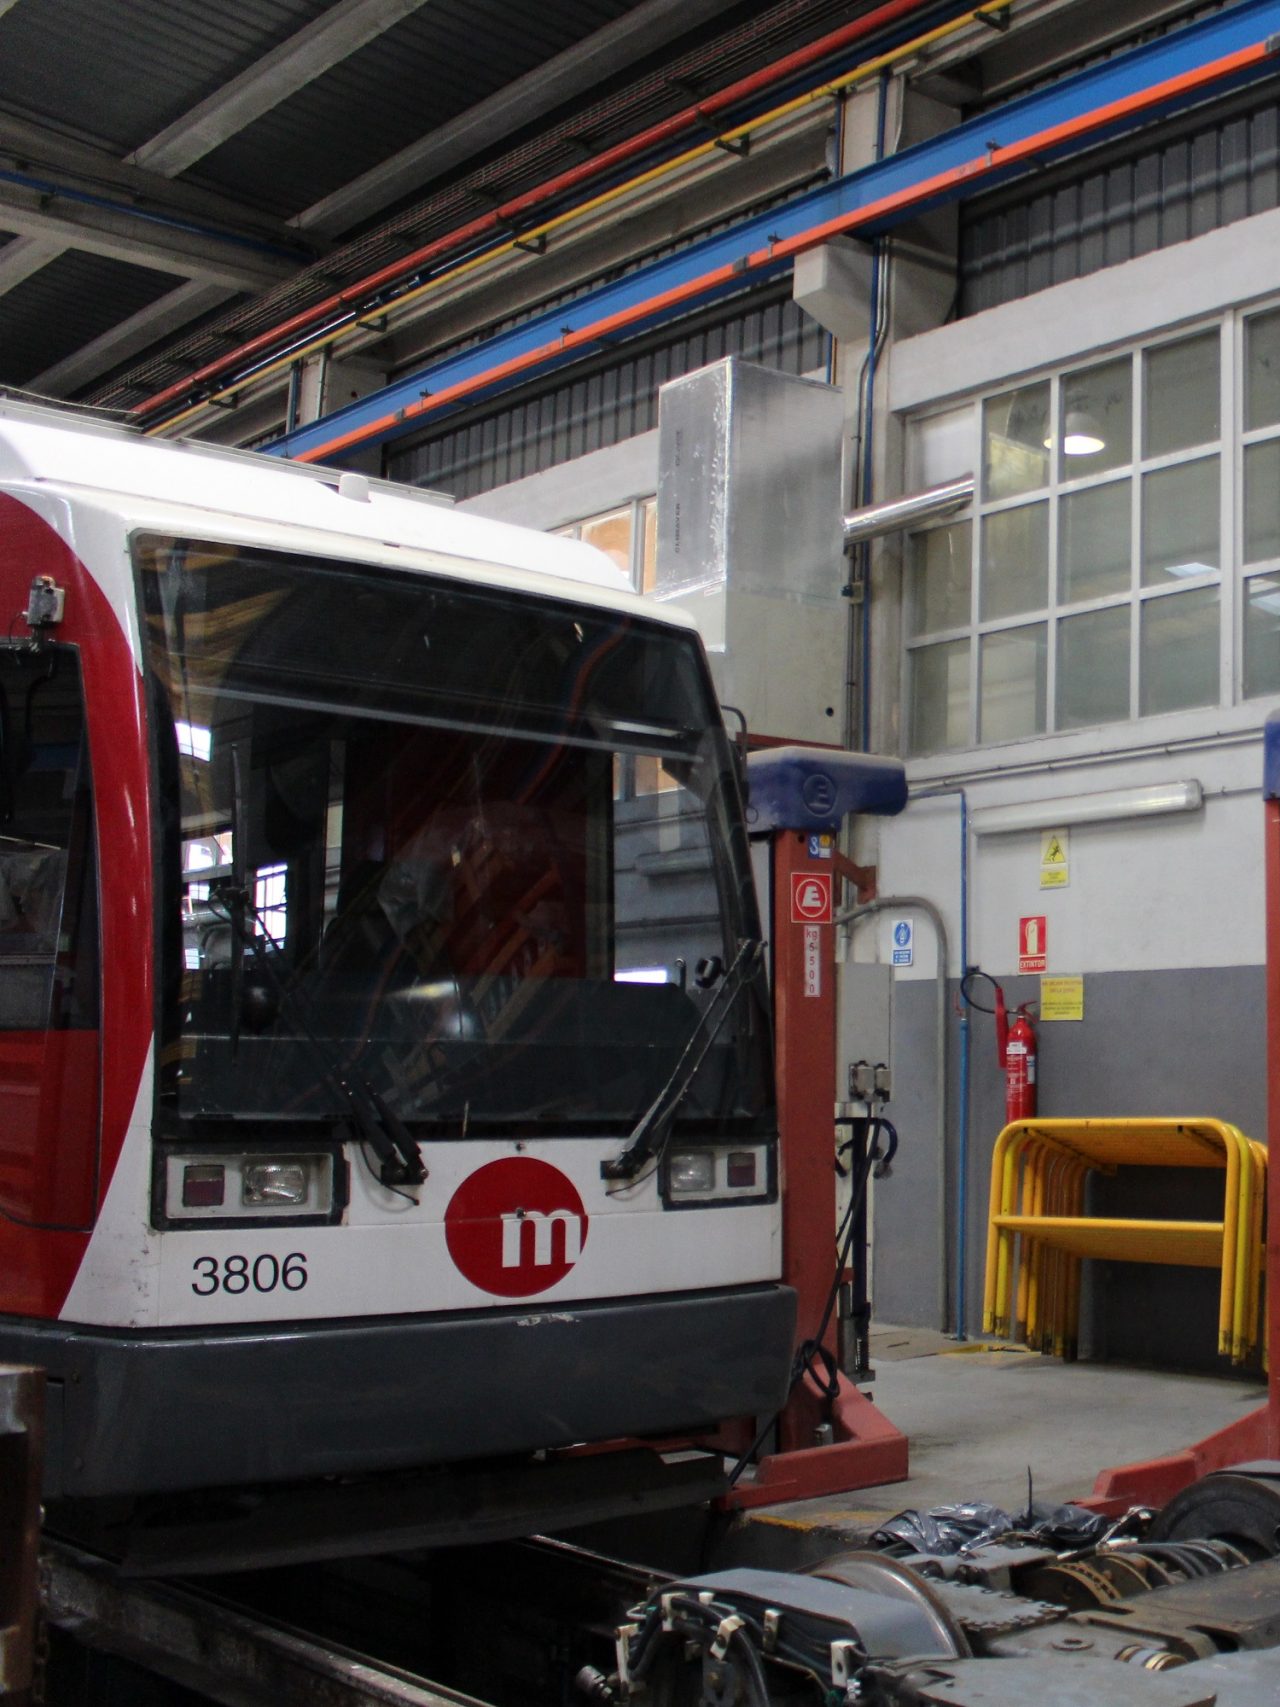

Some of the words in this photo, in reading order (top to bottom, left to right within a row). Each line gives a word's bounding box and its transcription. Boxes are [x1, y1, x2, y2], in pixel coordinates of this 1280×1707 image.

[801, 885, 822, 907] E
[501, 1208, 582, 1269] m
[191, 1253, 309, 1297] 3806
